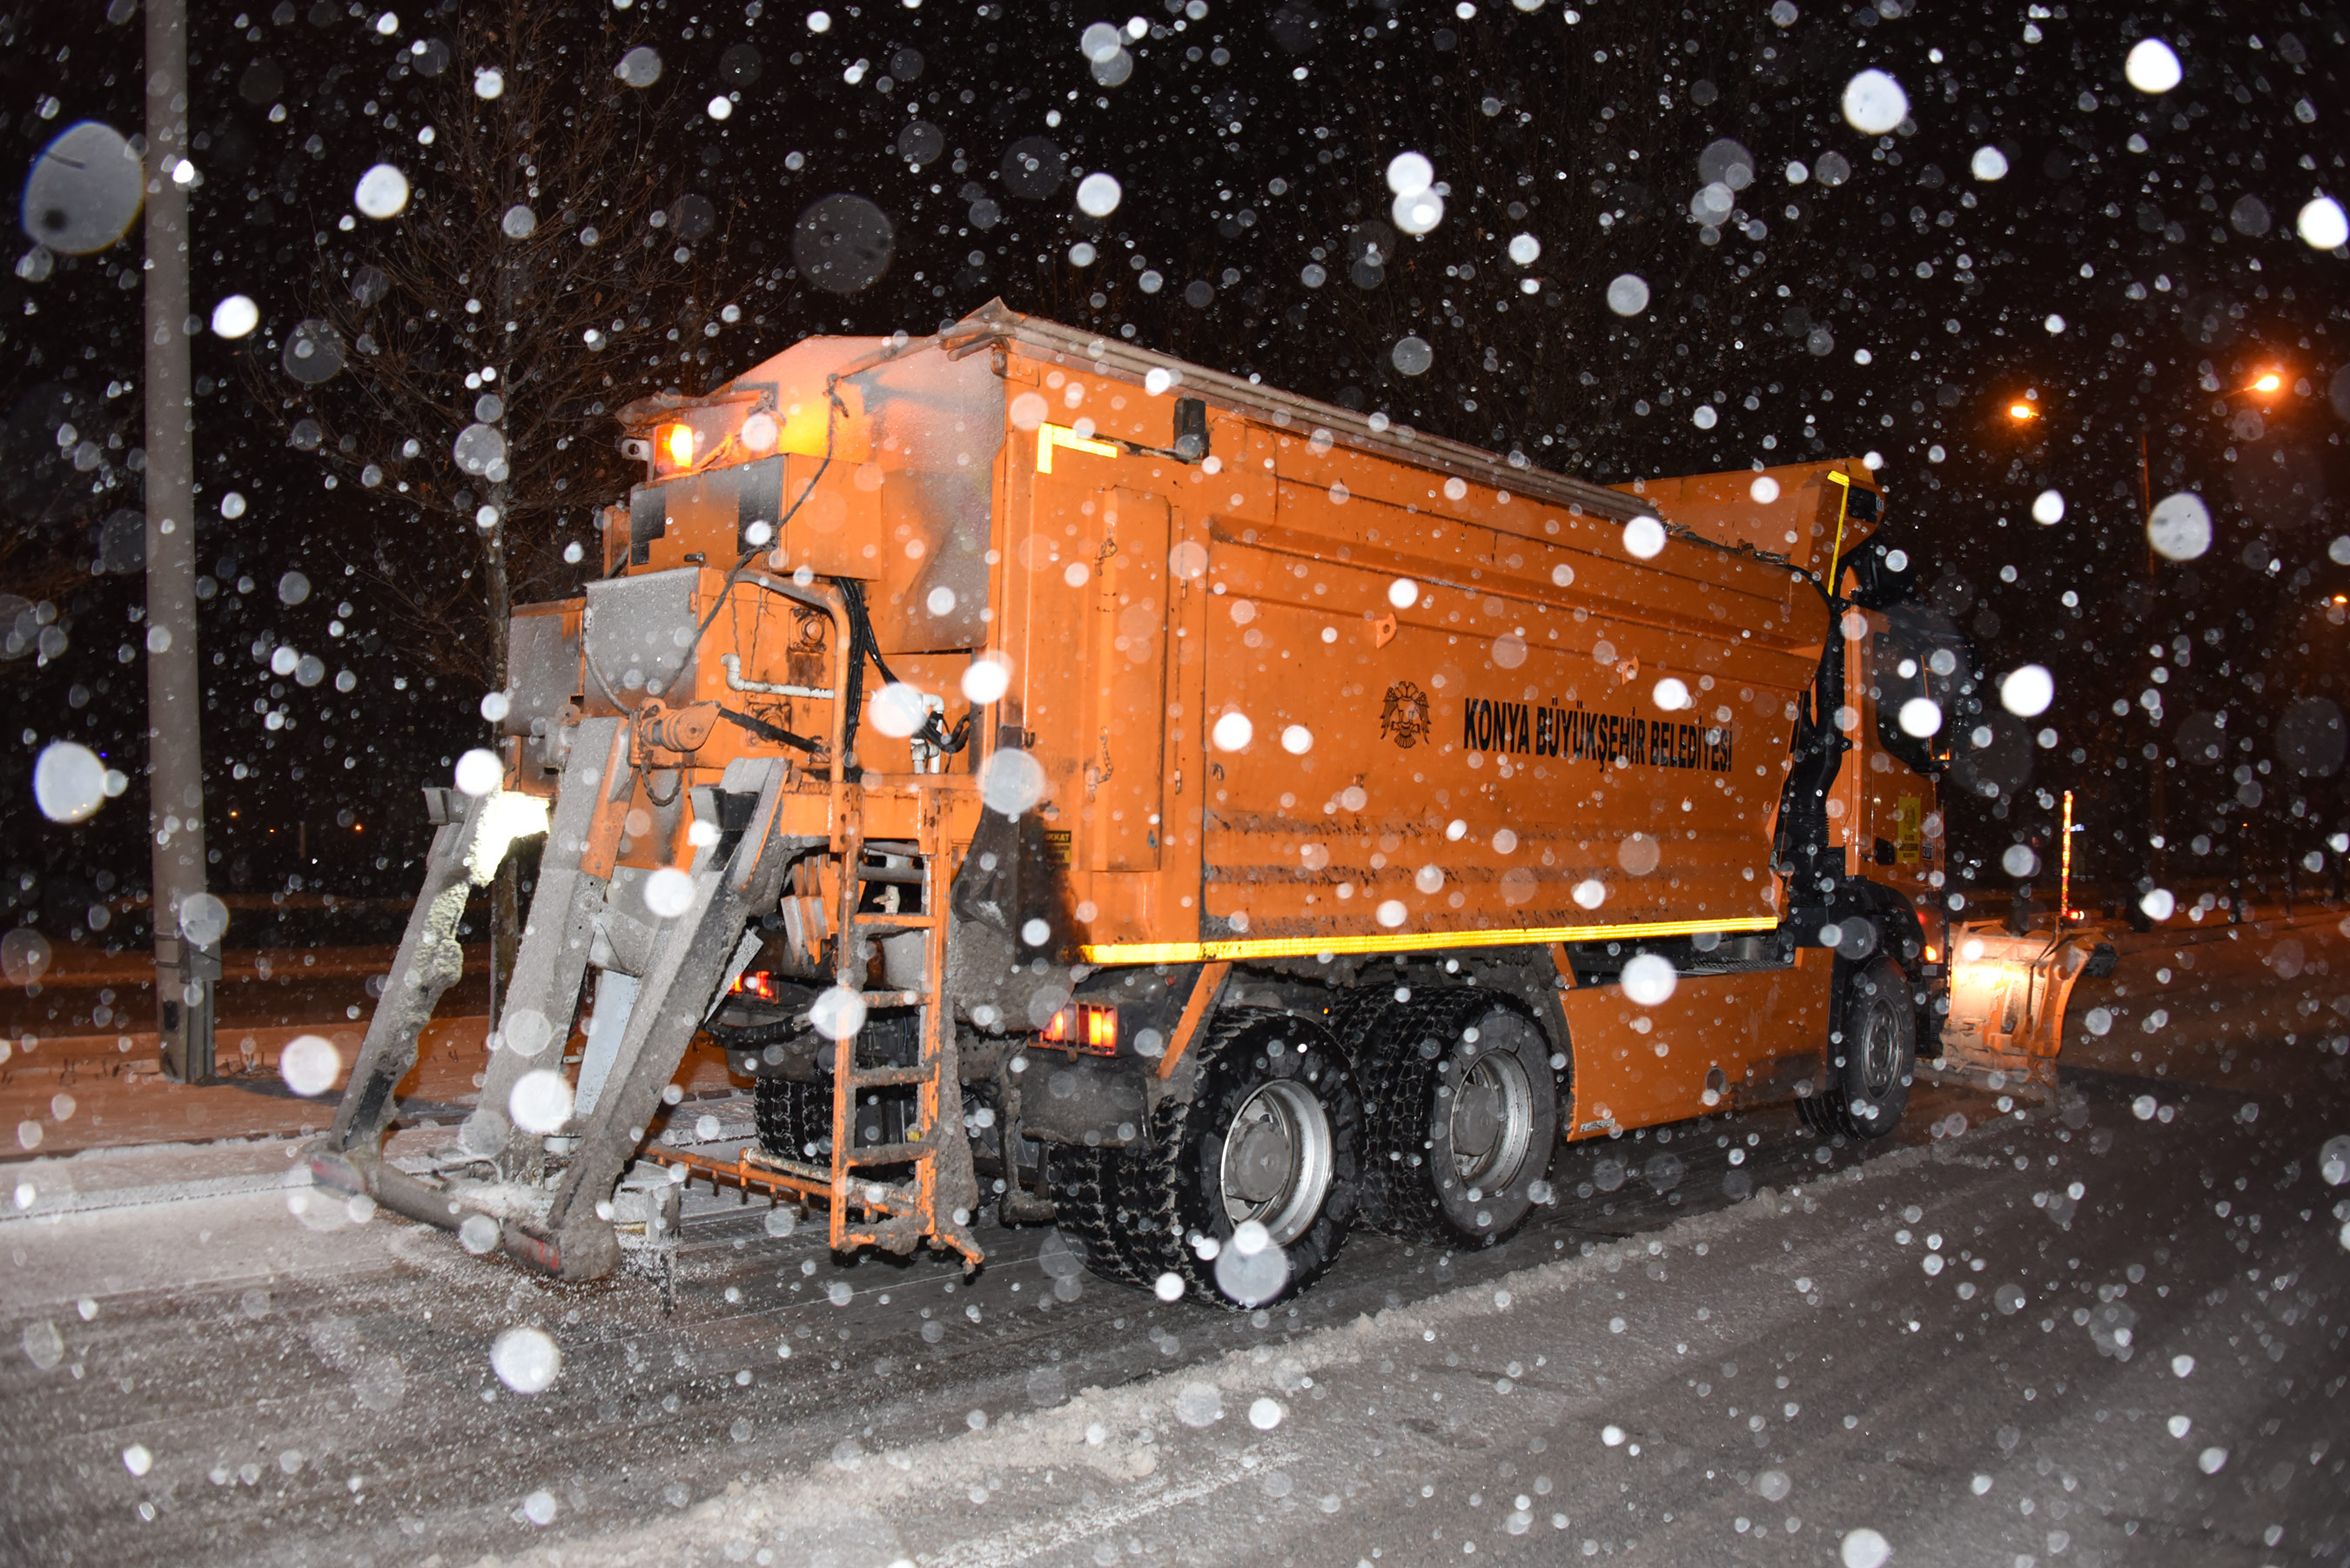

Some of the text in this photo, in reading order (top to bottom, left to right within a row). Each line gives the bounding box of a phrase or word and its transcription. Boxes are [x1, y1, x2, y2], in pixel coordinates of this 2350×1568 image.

[1464, 698, 1733, 773] KONYA BÜYÜKŞEHİR BELEDİYESİ
